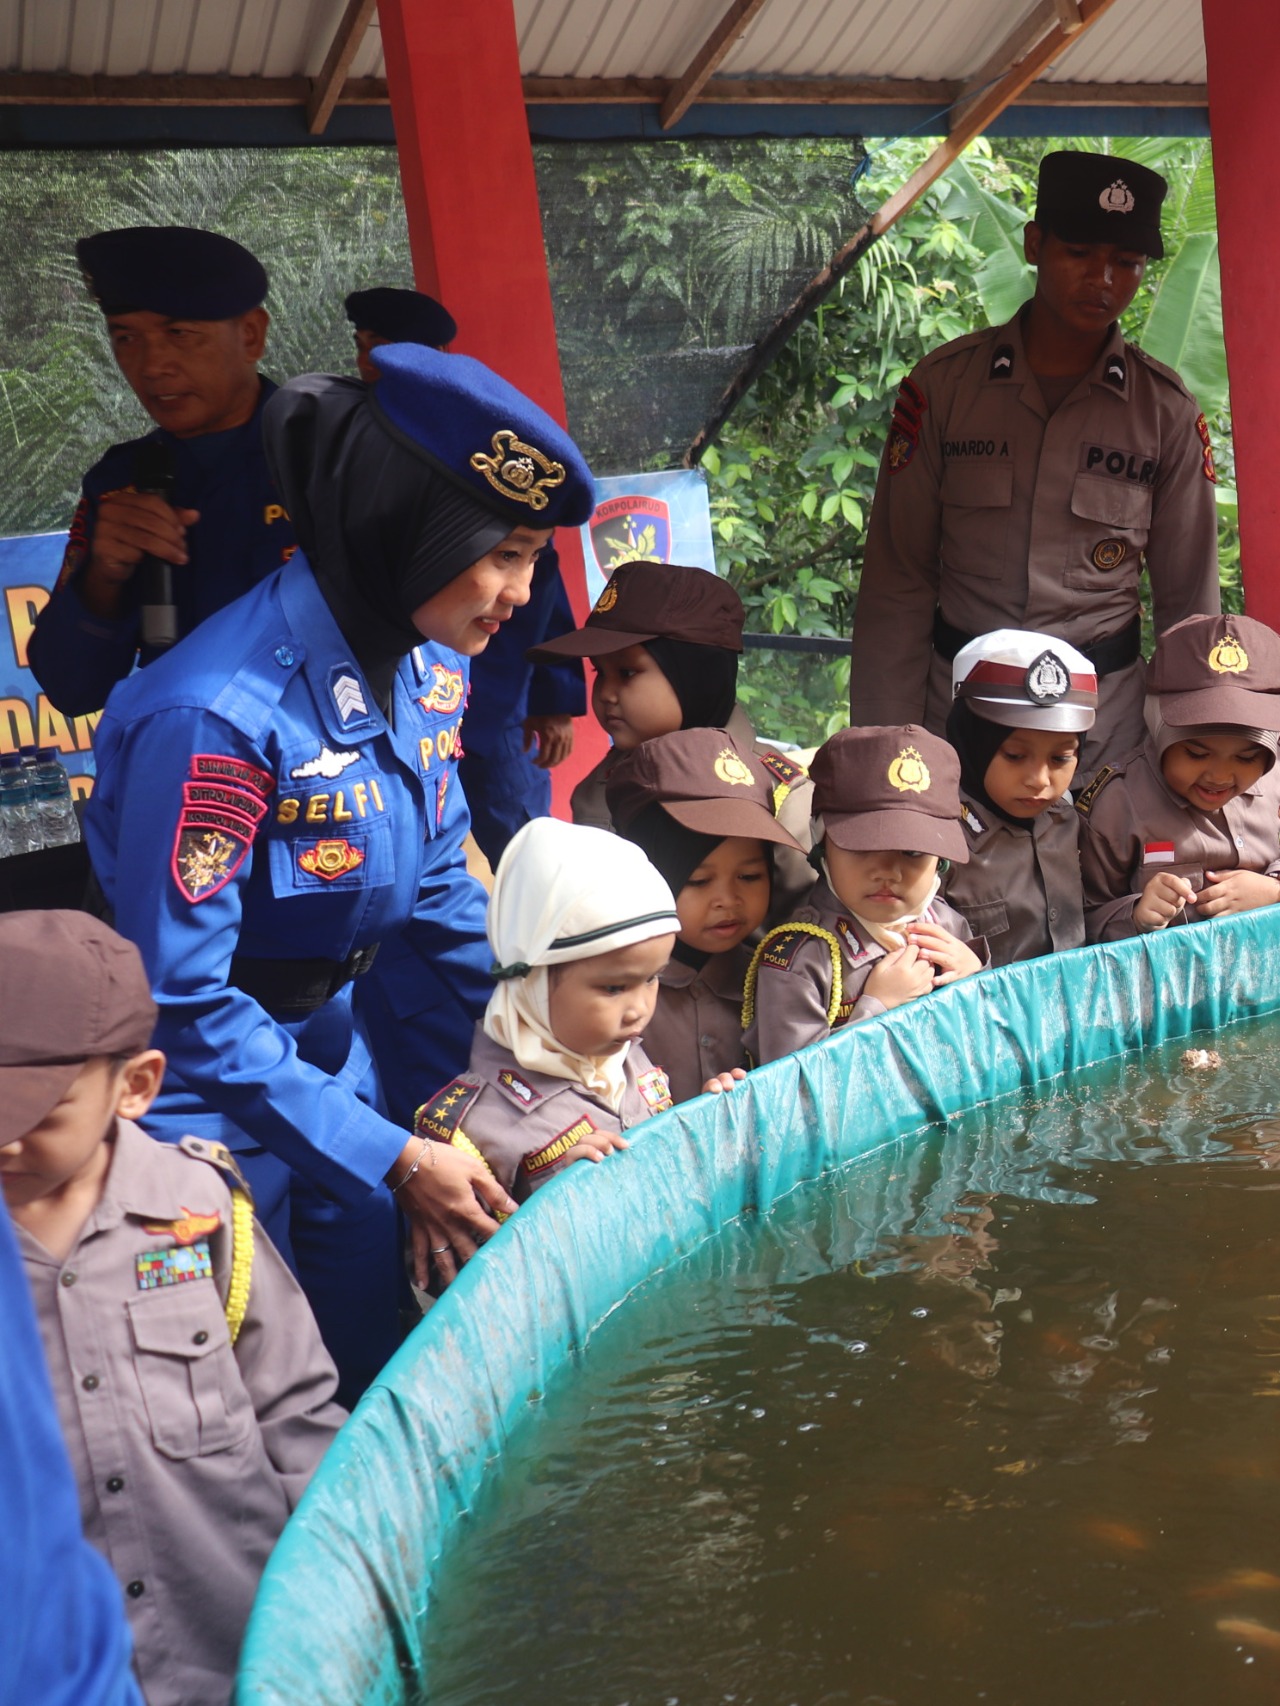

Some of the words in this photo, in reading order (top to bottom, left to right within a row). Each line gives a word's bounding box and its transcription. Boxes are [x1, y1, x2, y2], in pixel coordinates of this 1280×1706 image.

[1000, 441, 1009, 457] A
[595, 499, 660, 518] KORPOLAIRUD
[276, 779, 384, 825] SELFI
[763, 952, 789, 968] POLISI
[421, 1116, 452, 1140] POLISI
[524, 1118, 594, 1172] COMMANDO
